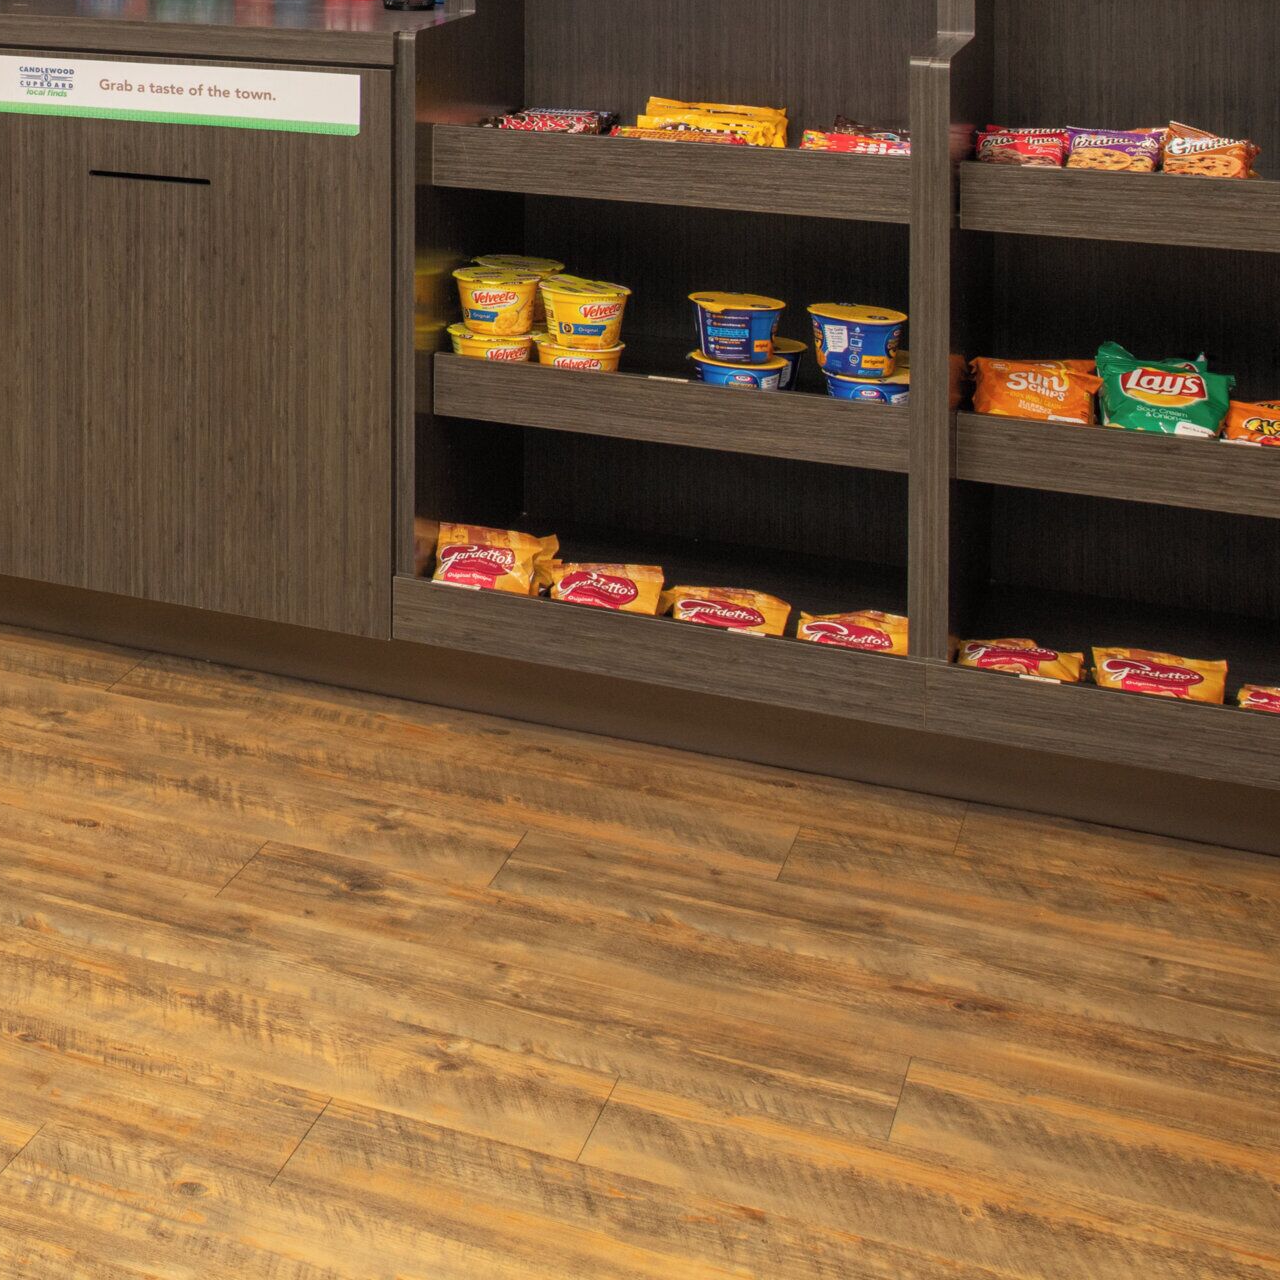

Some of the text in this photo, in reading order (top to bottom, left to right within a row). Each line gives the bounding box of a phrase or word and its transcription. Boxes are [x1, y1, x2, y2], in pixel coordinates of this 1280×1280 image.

[19, 66, 74, 75] CANDLEWOOD
[20, 80, 74, 89] CUPBOARD
[99, 78, 276, 101] Grab a taste of the town.
[26, 88, 68, 97] local finds
[474, 291, 516, 304] Velveeta
[583, 303, 622, 317] Velveeta
[1127, 369, 1202, 394] Lay's
